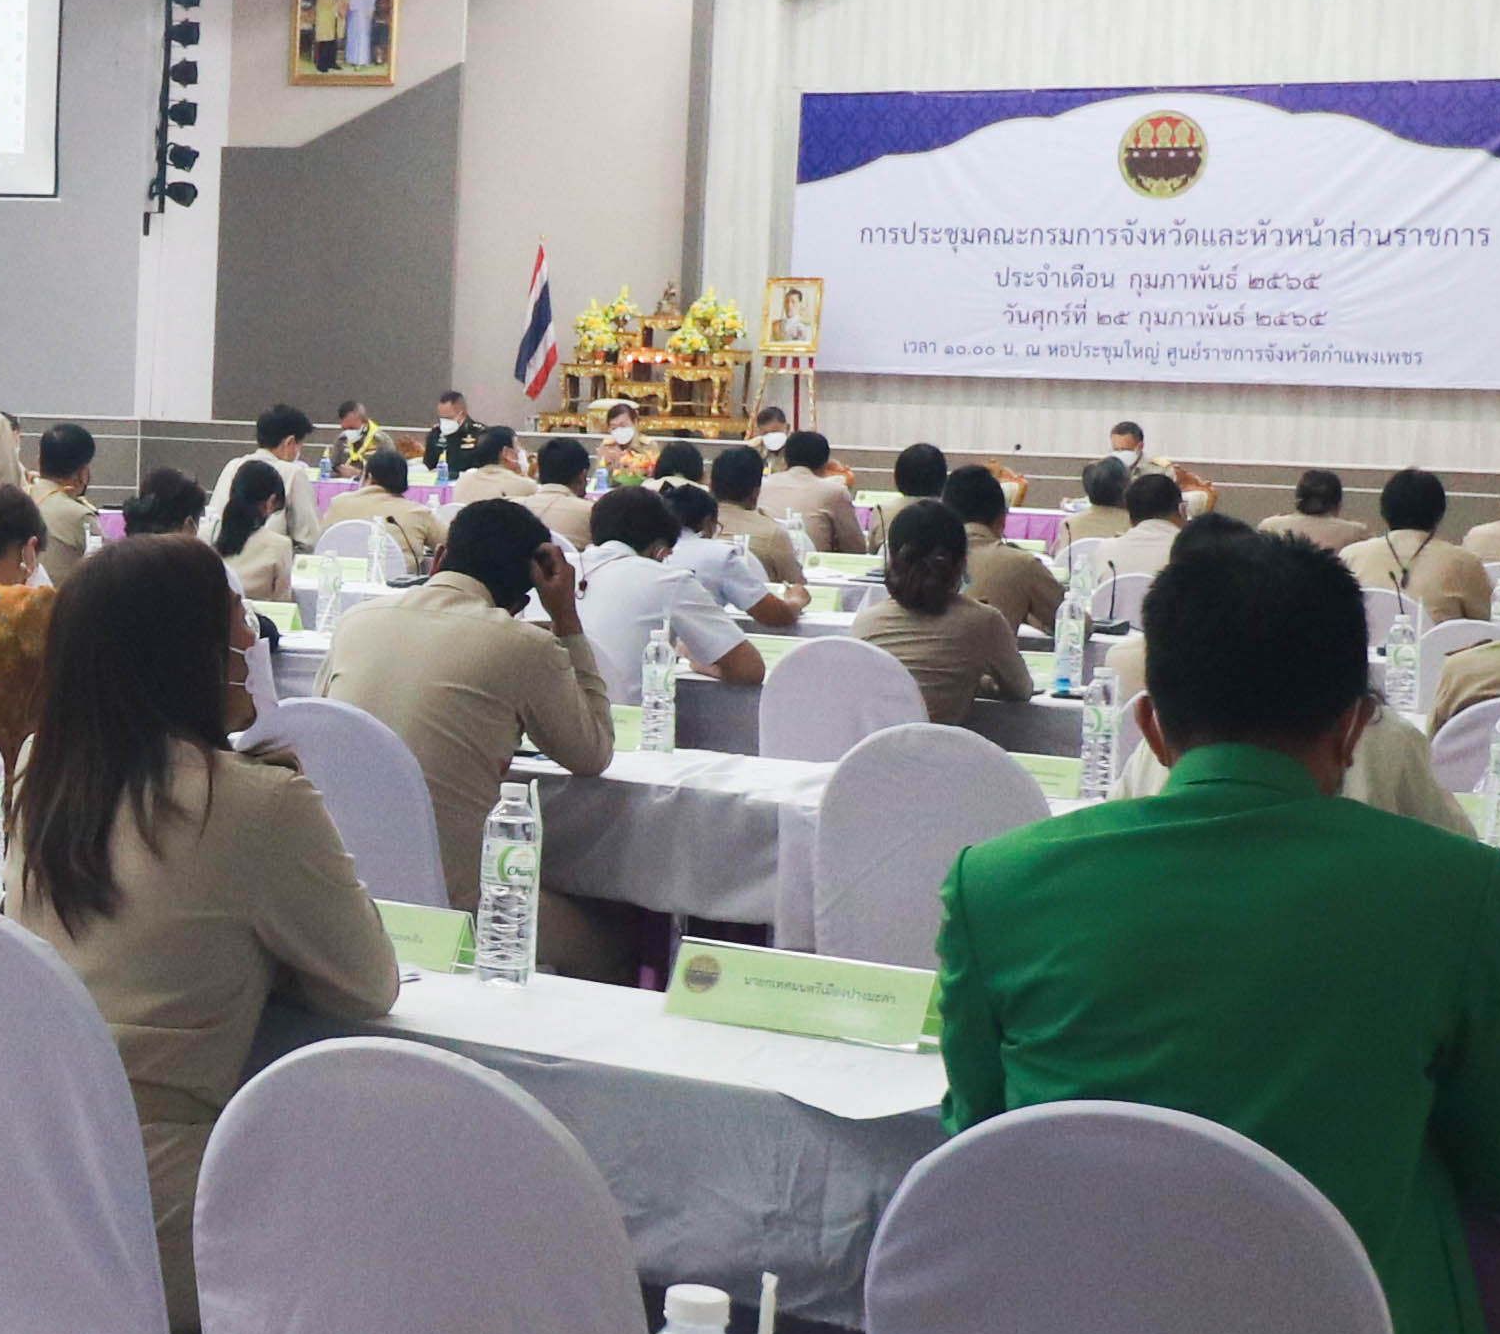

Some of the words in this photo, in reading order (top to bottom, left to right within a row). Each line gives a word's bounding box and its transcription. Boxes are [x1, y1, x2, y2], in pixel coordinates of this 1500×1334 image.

[859, 218, 1490, 254] การประชุมคณะกรมการจังหวัดและหัวหน้าส่วนราชการ
[995, 263, 1115, 289] ประจำเดือน
[1129, 264, 1239, 297] กุมภาพันธ์
[1248, 273, 1323, 291] ๒๕๖๕
[1002, 299, 1087, 331] วันศุกร์ที่
[1096, 310, 1129, 326] ๒๕
[1139, 304, 1245, 333] กุมภาพันธ์
[1255, 310, 1328, 327] ๒๕๖๕
[903, 339, 937, 355] เวลา
[944, 345, 996, 355] ๑๐.๐๐
[1003, 342, 1018, 356] น.
[1026, 344, 1040, 357] ณ
[1048, 338, 1160, 366] หอประชุมใหญ่
[1166, 341, 1423, 367] ศูนย์ราชการจังหวัดกำแพงเพชร
